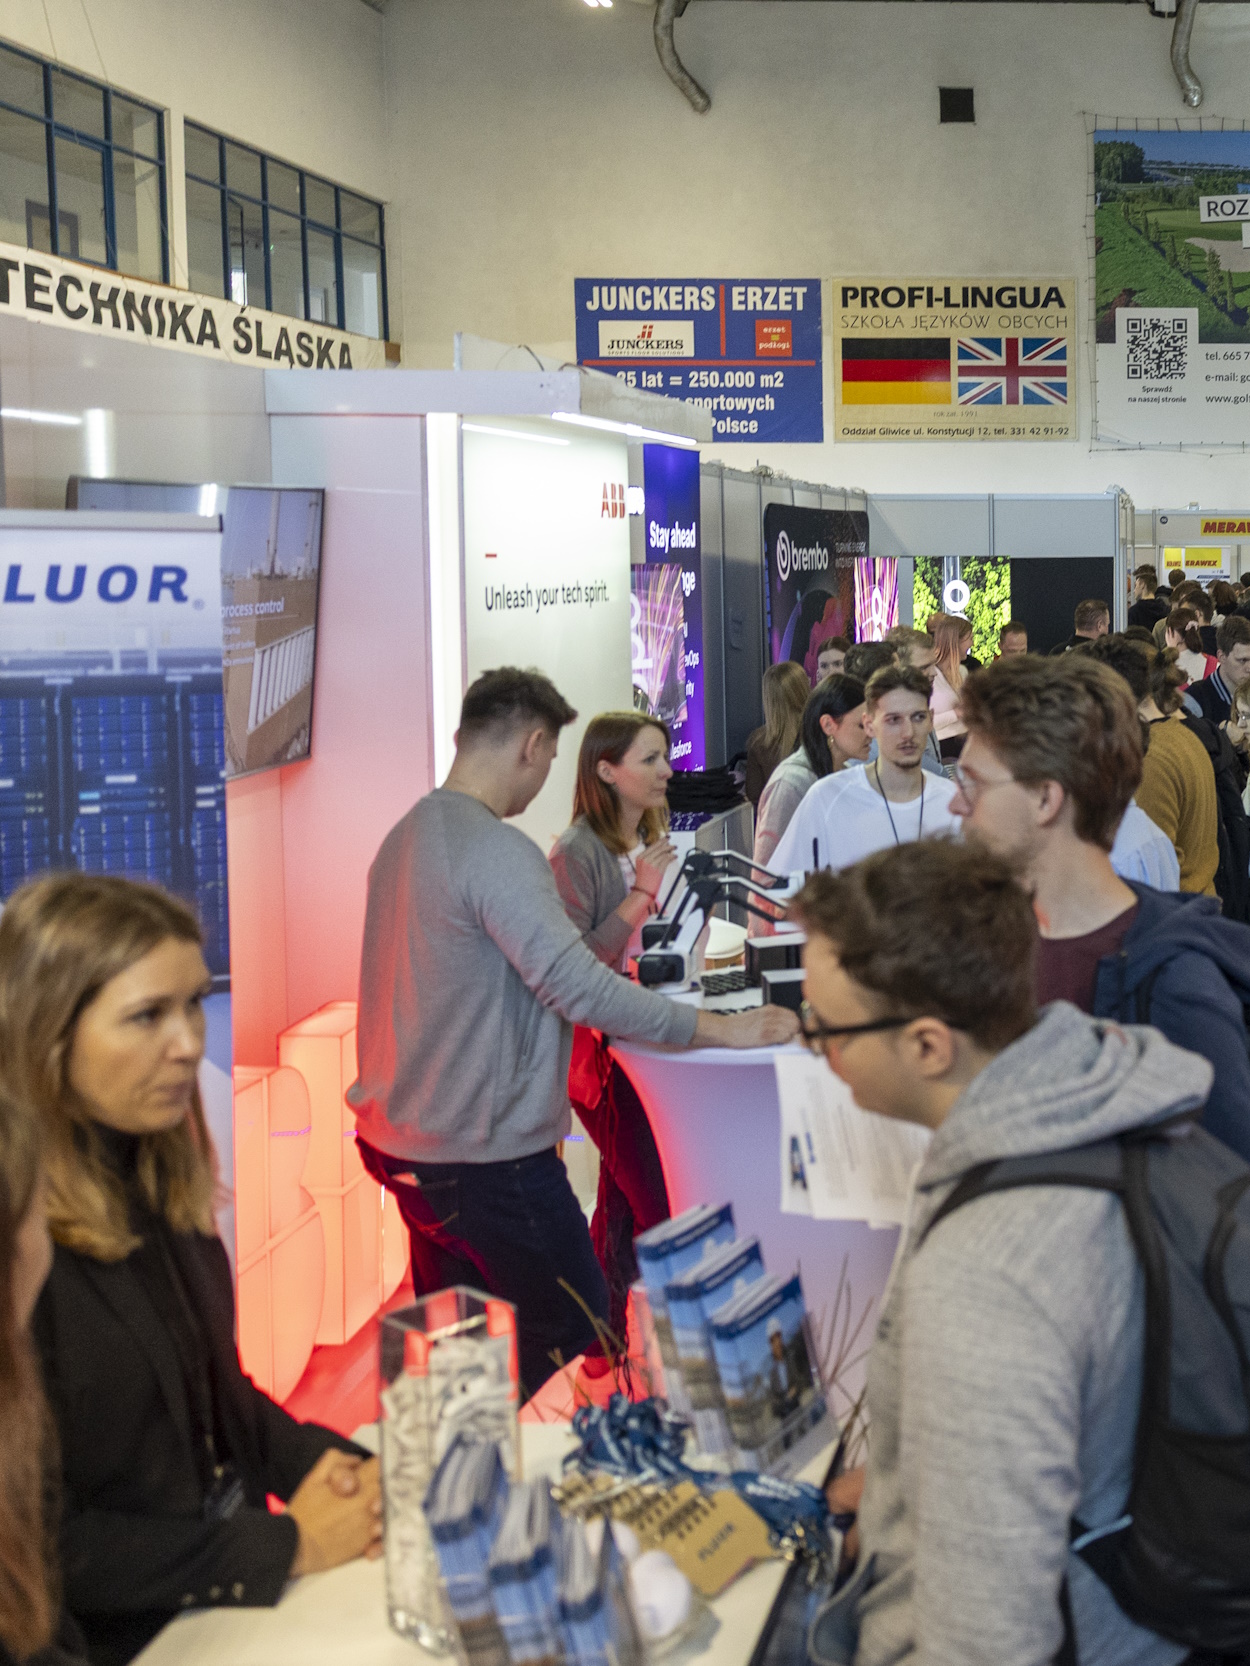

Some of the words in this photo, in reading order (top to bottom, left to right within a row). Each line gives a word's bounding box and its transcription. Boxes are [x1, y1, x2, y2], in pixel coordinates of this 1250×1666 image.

[586, 286, 716, 312] JUNCKERS
[731, 286, 808, 312] ERZET
[841, 286, 1066, 309] PROFI-LINGUA
[0, 258, 220, 350] TECHNIKA
[232, 307, 354, 370] ŚLĄSKA
[841, 315, 904, 329] SZKOŁA
[911, 312, 991, 331] JĘZYKÓW
[998, 315, 1068, 329] OBCYCH
[607, 339, 684, 350] JUNCKERS
[1205, 351, 1221, 361] tel.
[1223, 351, 1242, 361] 665
[642, 370, 663, 388] lat
[688, 371, 755, 388] 250.000
[760, 371, 784, 388] m2
[1205, 372, 1238, 382] e-mail:
[1142, 385, 1173, 393] Sprawdź
[1138, 396, 1160, 404] naszej
[879, 427, 911, 436] Gliwice
[913, 427, 924, 436] ul.
[927, 427, 975, 437] Konstytucji
[978, 427, 991, 437] 12,
[993, 427, 1007, 436] tel.
[1010, 427, 1026, 436] 331
[1029, 427, 1041, 436] 42
[1044, 427, 1069, 436] 91-92
[601, 482, 625, 519] ABB
[649, 520, 669, 553] Stay
[670, 521, 696, 549] ahead
[791, 541, 829, 572] brembo
[254, 596, 285, 614] control
[485, 583, 533, 611] Unleash
[535, 587, 559, 613] your
[561, 580, 582, 605] tech
[584, 579, 610, 608] spirit.
